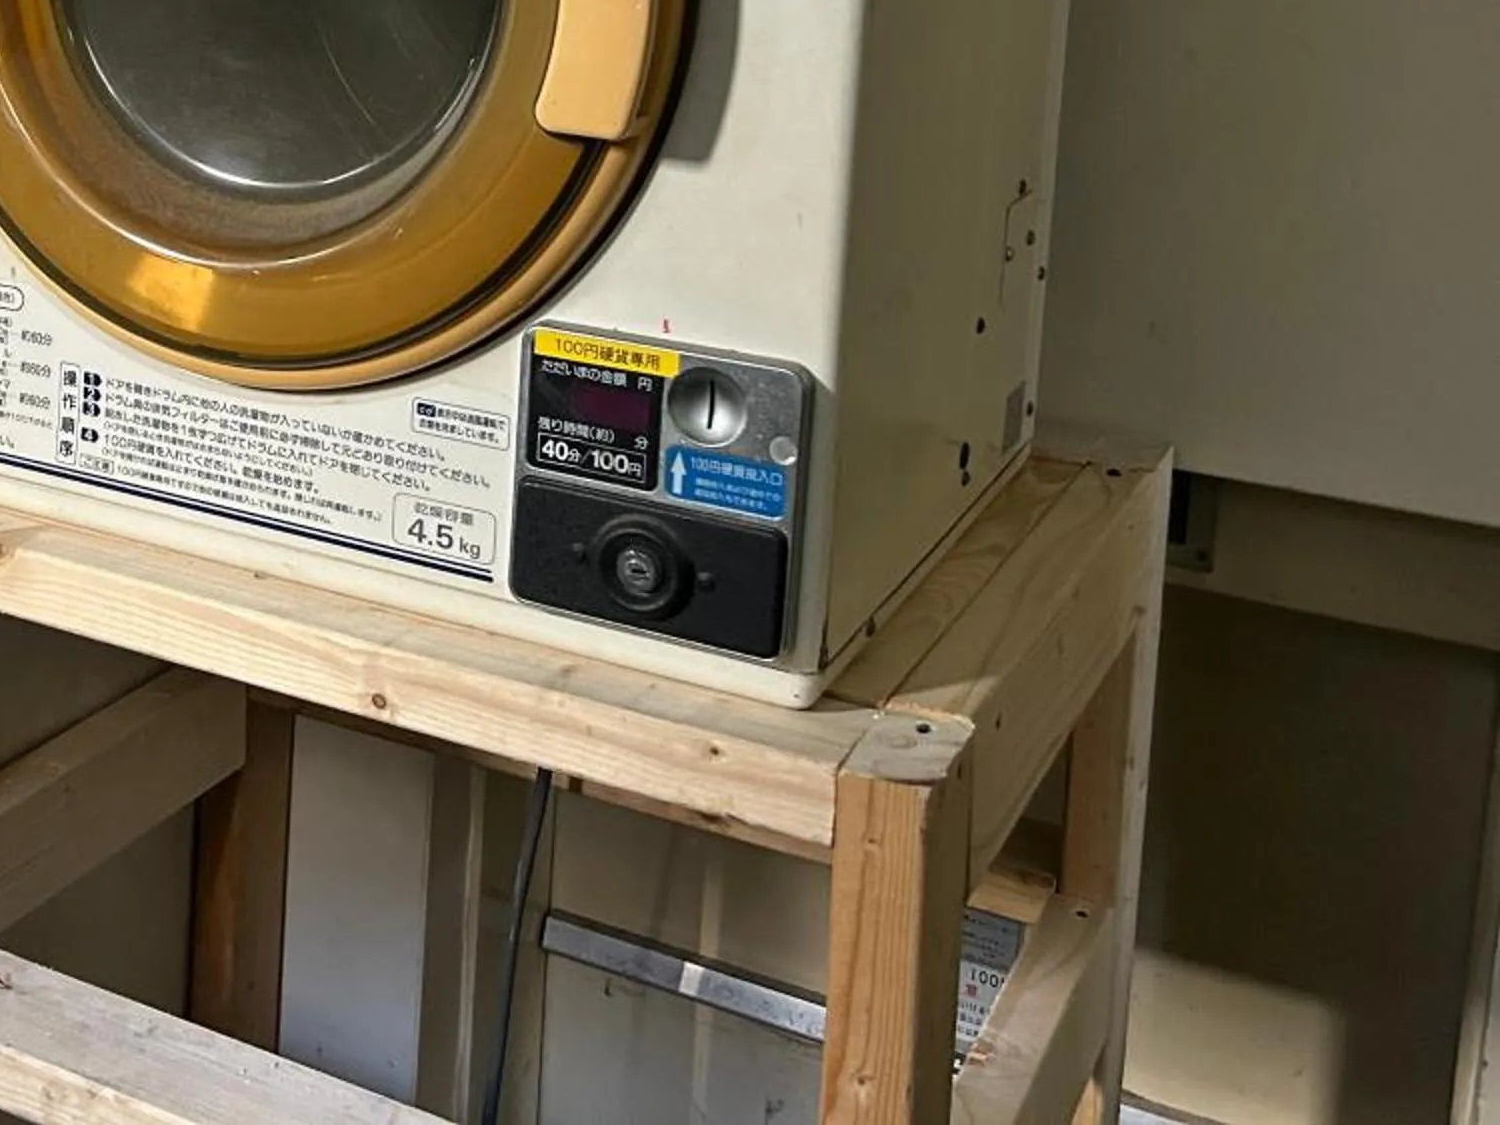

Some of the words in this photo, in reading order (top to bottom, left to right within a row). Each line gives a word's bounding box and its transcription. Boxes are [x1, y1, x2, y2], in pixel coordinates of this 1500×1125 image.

[555, 338, 661, 370] 100円硬貨専用
[637, 375, 653, 392] 円
[59, 369, 78, 458] 操作順序
[633, 435, 648, 450] 分
[414, 502, 474, 526] 乾燥容量
[408, 518, 454, 549] 4.5
[459, 536, 481, 559] kg
